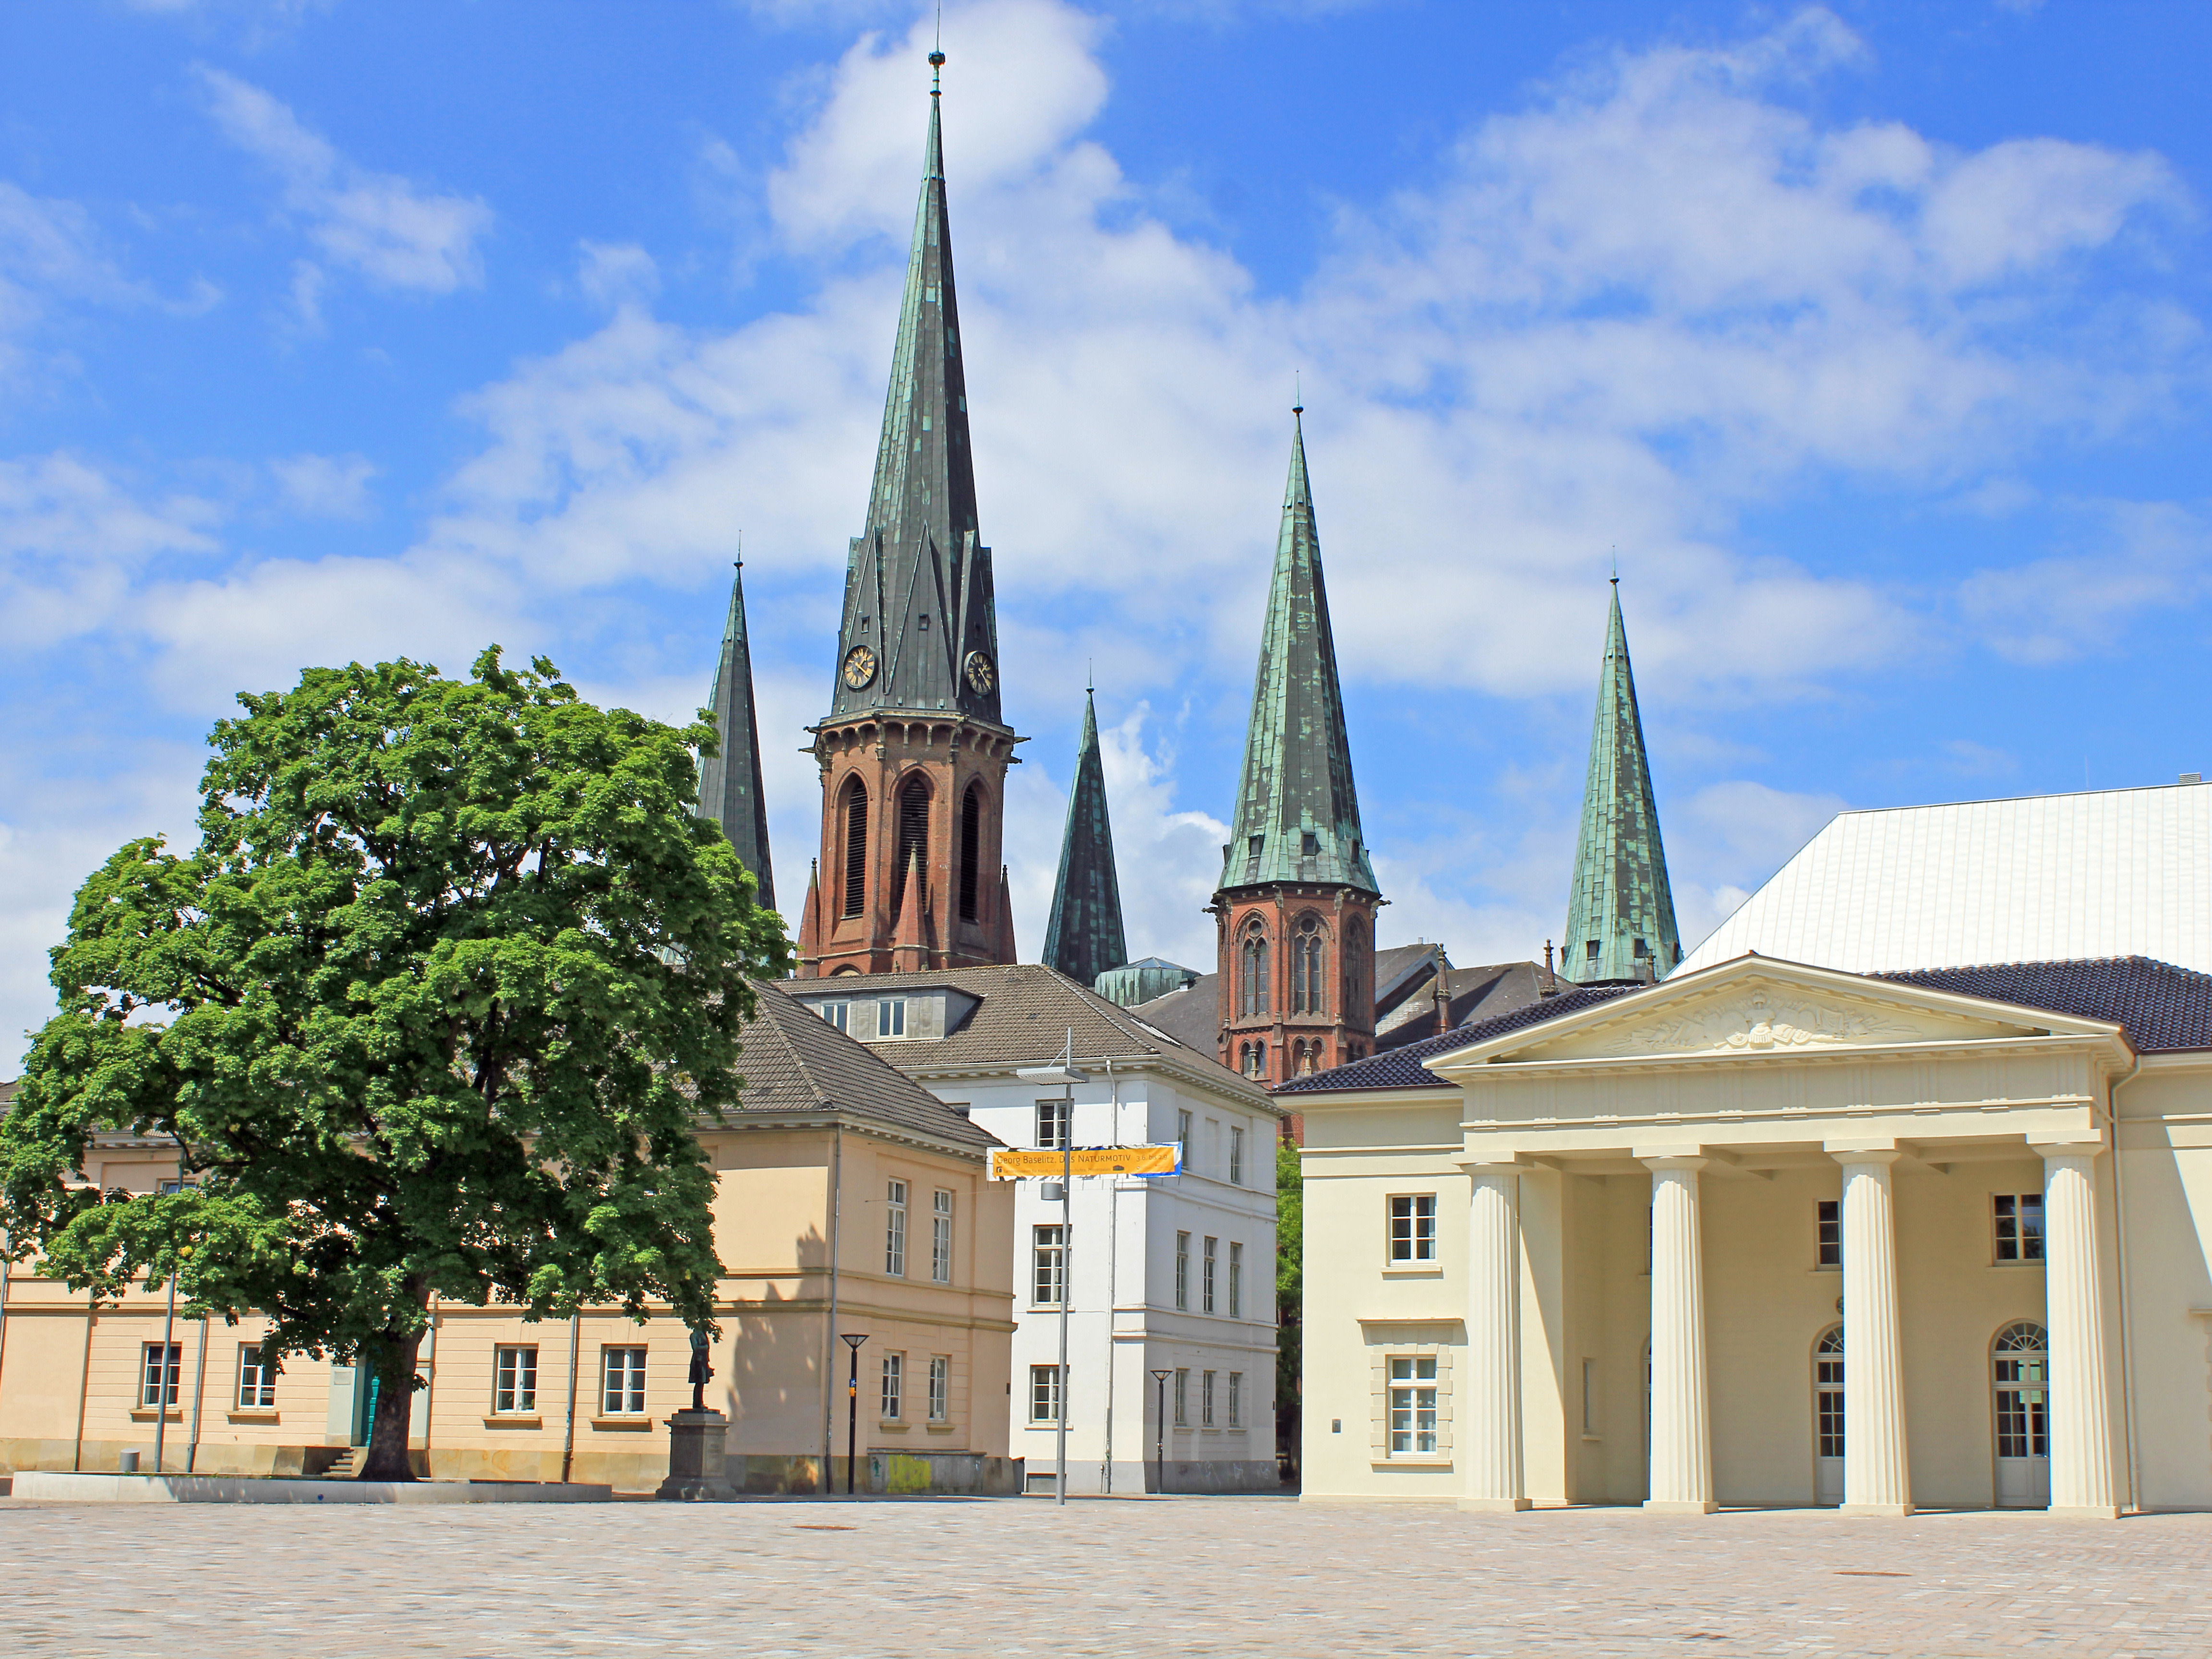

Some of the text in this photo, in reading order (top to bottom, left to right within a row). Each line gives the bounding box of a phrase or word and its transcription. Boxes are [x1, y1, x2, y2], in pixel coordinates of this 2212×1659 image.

[997, 1155, 1021, 1166] Georg
[1023, 1155, 1057, 1164] Baselitz.
[1059, 1155, 1075, 1163] DS
